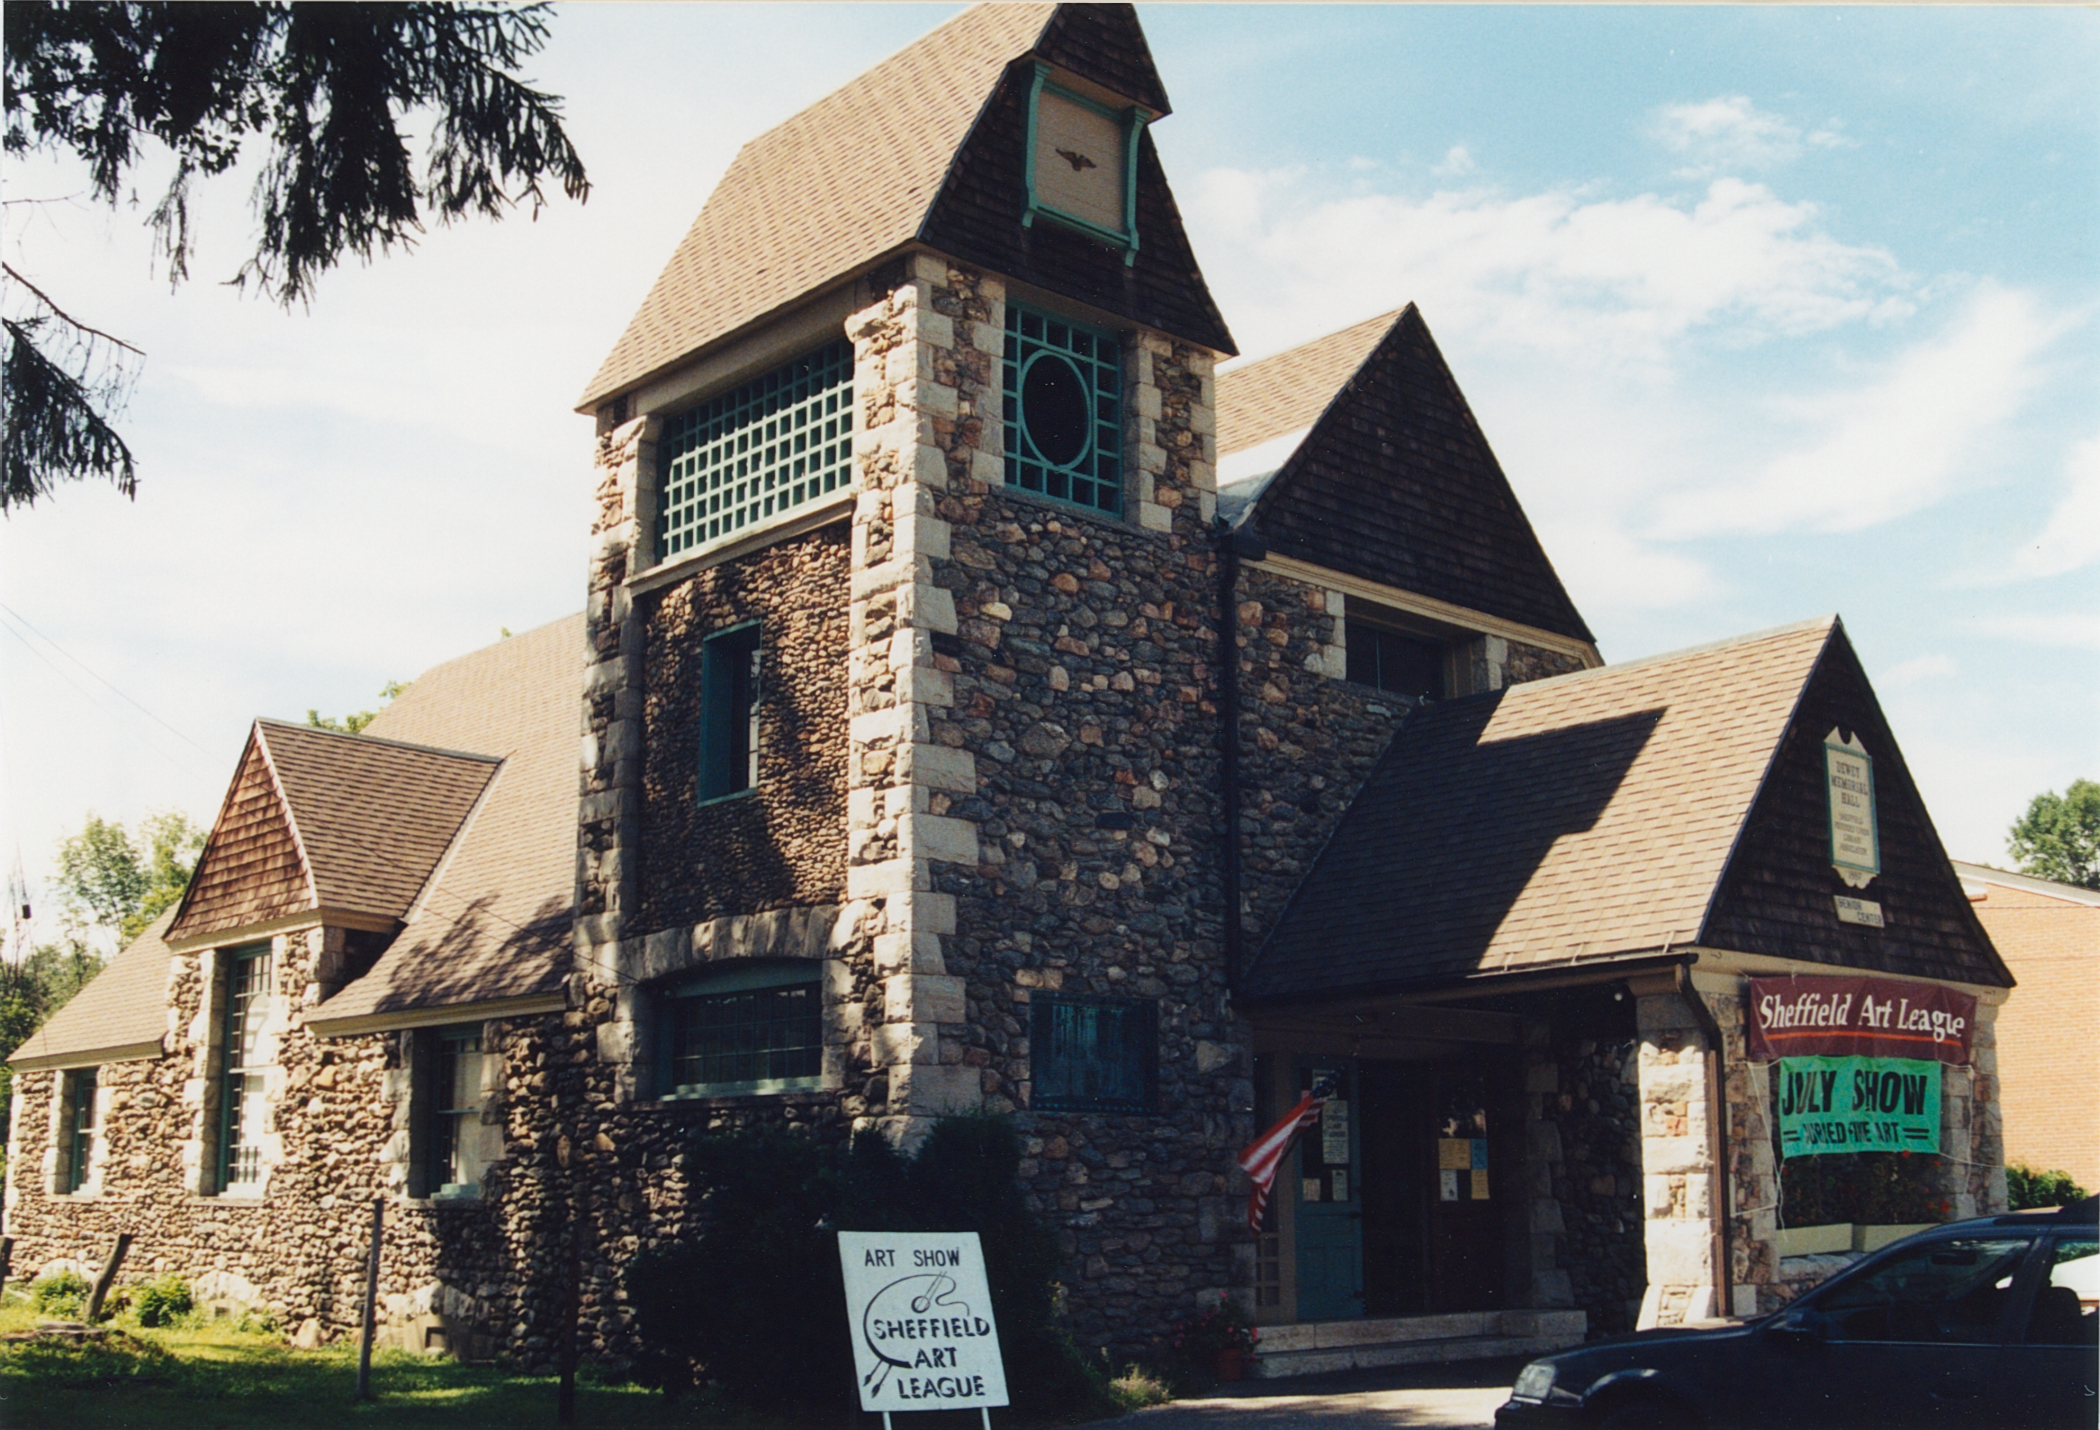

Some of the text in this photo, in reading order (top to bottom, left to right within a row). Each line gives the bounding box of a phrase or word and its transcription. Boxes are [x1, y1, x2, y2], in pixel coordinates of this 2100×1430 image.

[1836, 760, 1860, 779] DEWEY
[1830, 775, 1869, 796] MEMORIAL
[1841, 792, 1860, 808] HALL
[1838, 898, 1862, 911] SENIOR
[1856, 911, 1884, 926] CENTER
[1760, 993, 1965, 1043] Sheffield Art League
[1782, 1069, 1928, 1116] JULY SHOW
[864, 1247, 960, 1267] ART SHOW
[873, 1316, 990, 1340] SHEFFIELD
[914, 1347, 957, 1369] ART
[897, 1375, 986, 1399] LEAGUE
